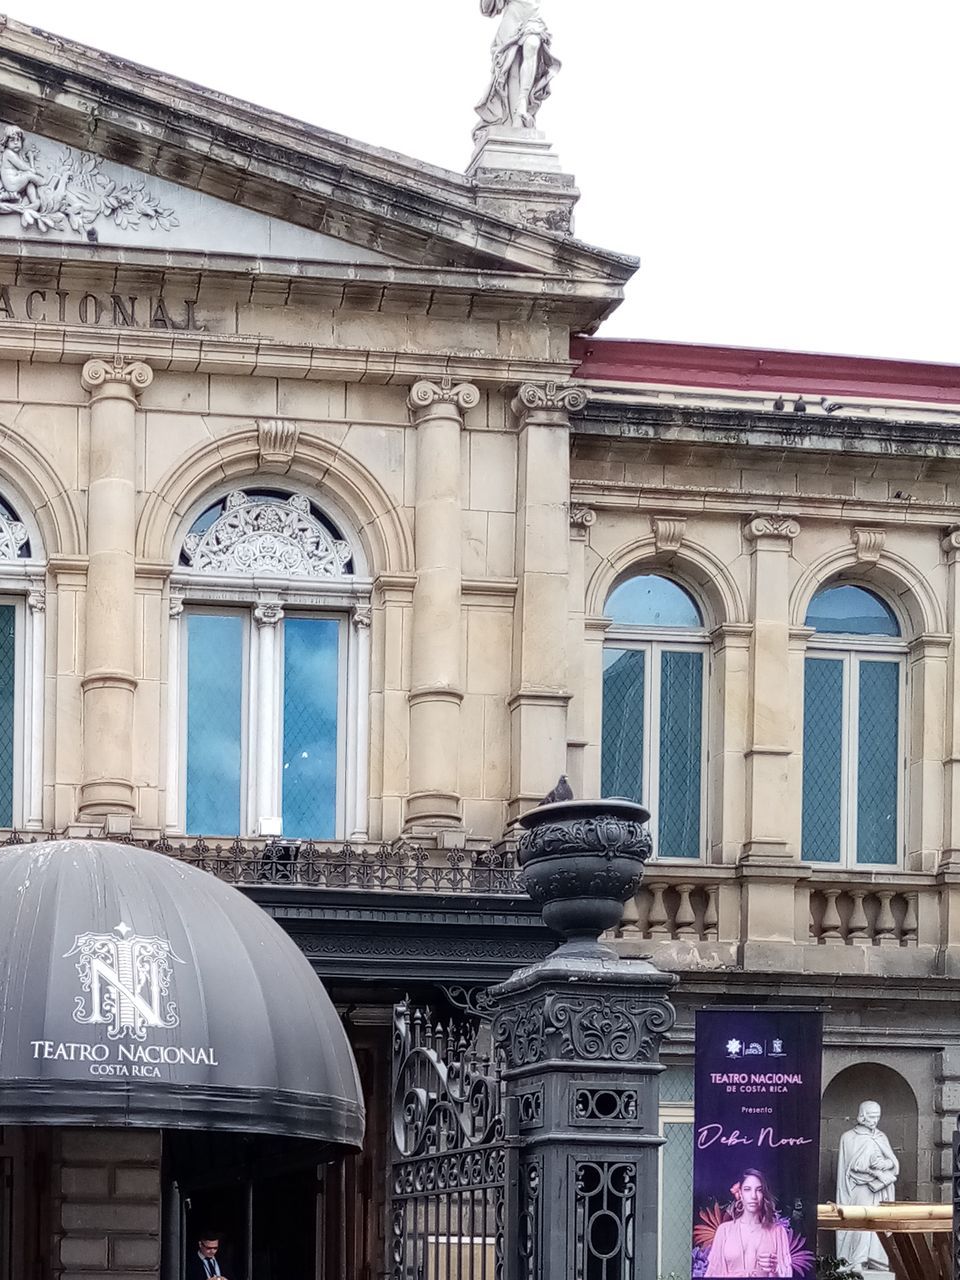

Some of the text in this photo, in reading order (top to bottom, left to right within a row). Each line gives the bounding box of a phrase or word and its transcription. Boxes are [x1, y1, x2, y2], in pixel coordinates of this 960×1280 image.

[30, 1040, 219, 1066] TEATRO NACIONAL
[89, 1064, 162, 1078] COSTA RICA
[710, 1073, 803, 1085] TEATRO NACIONAL
[697, 1123, 813, 1149] Debi Nova
